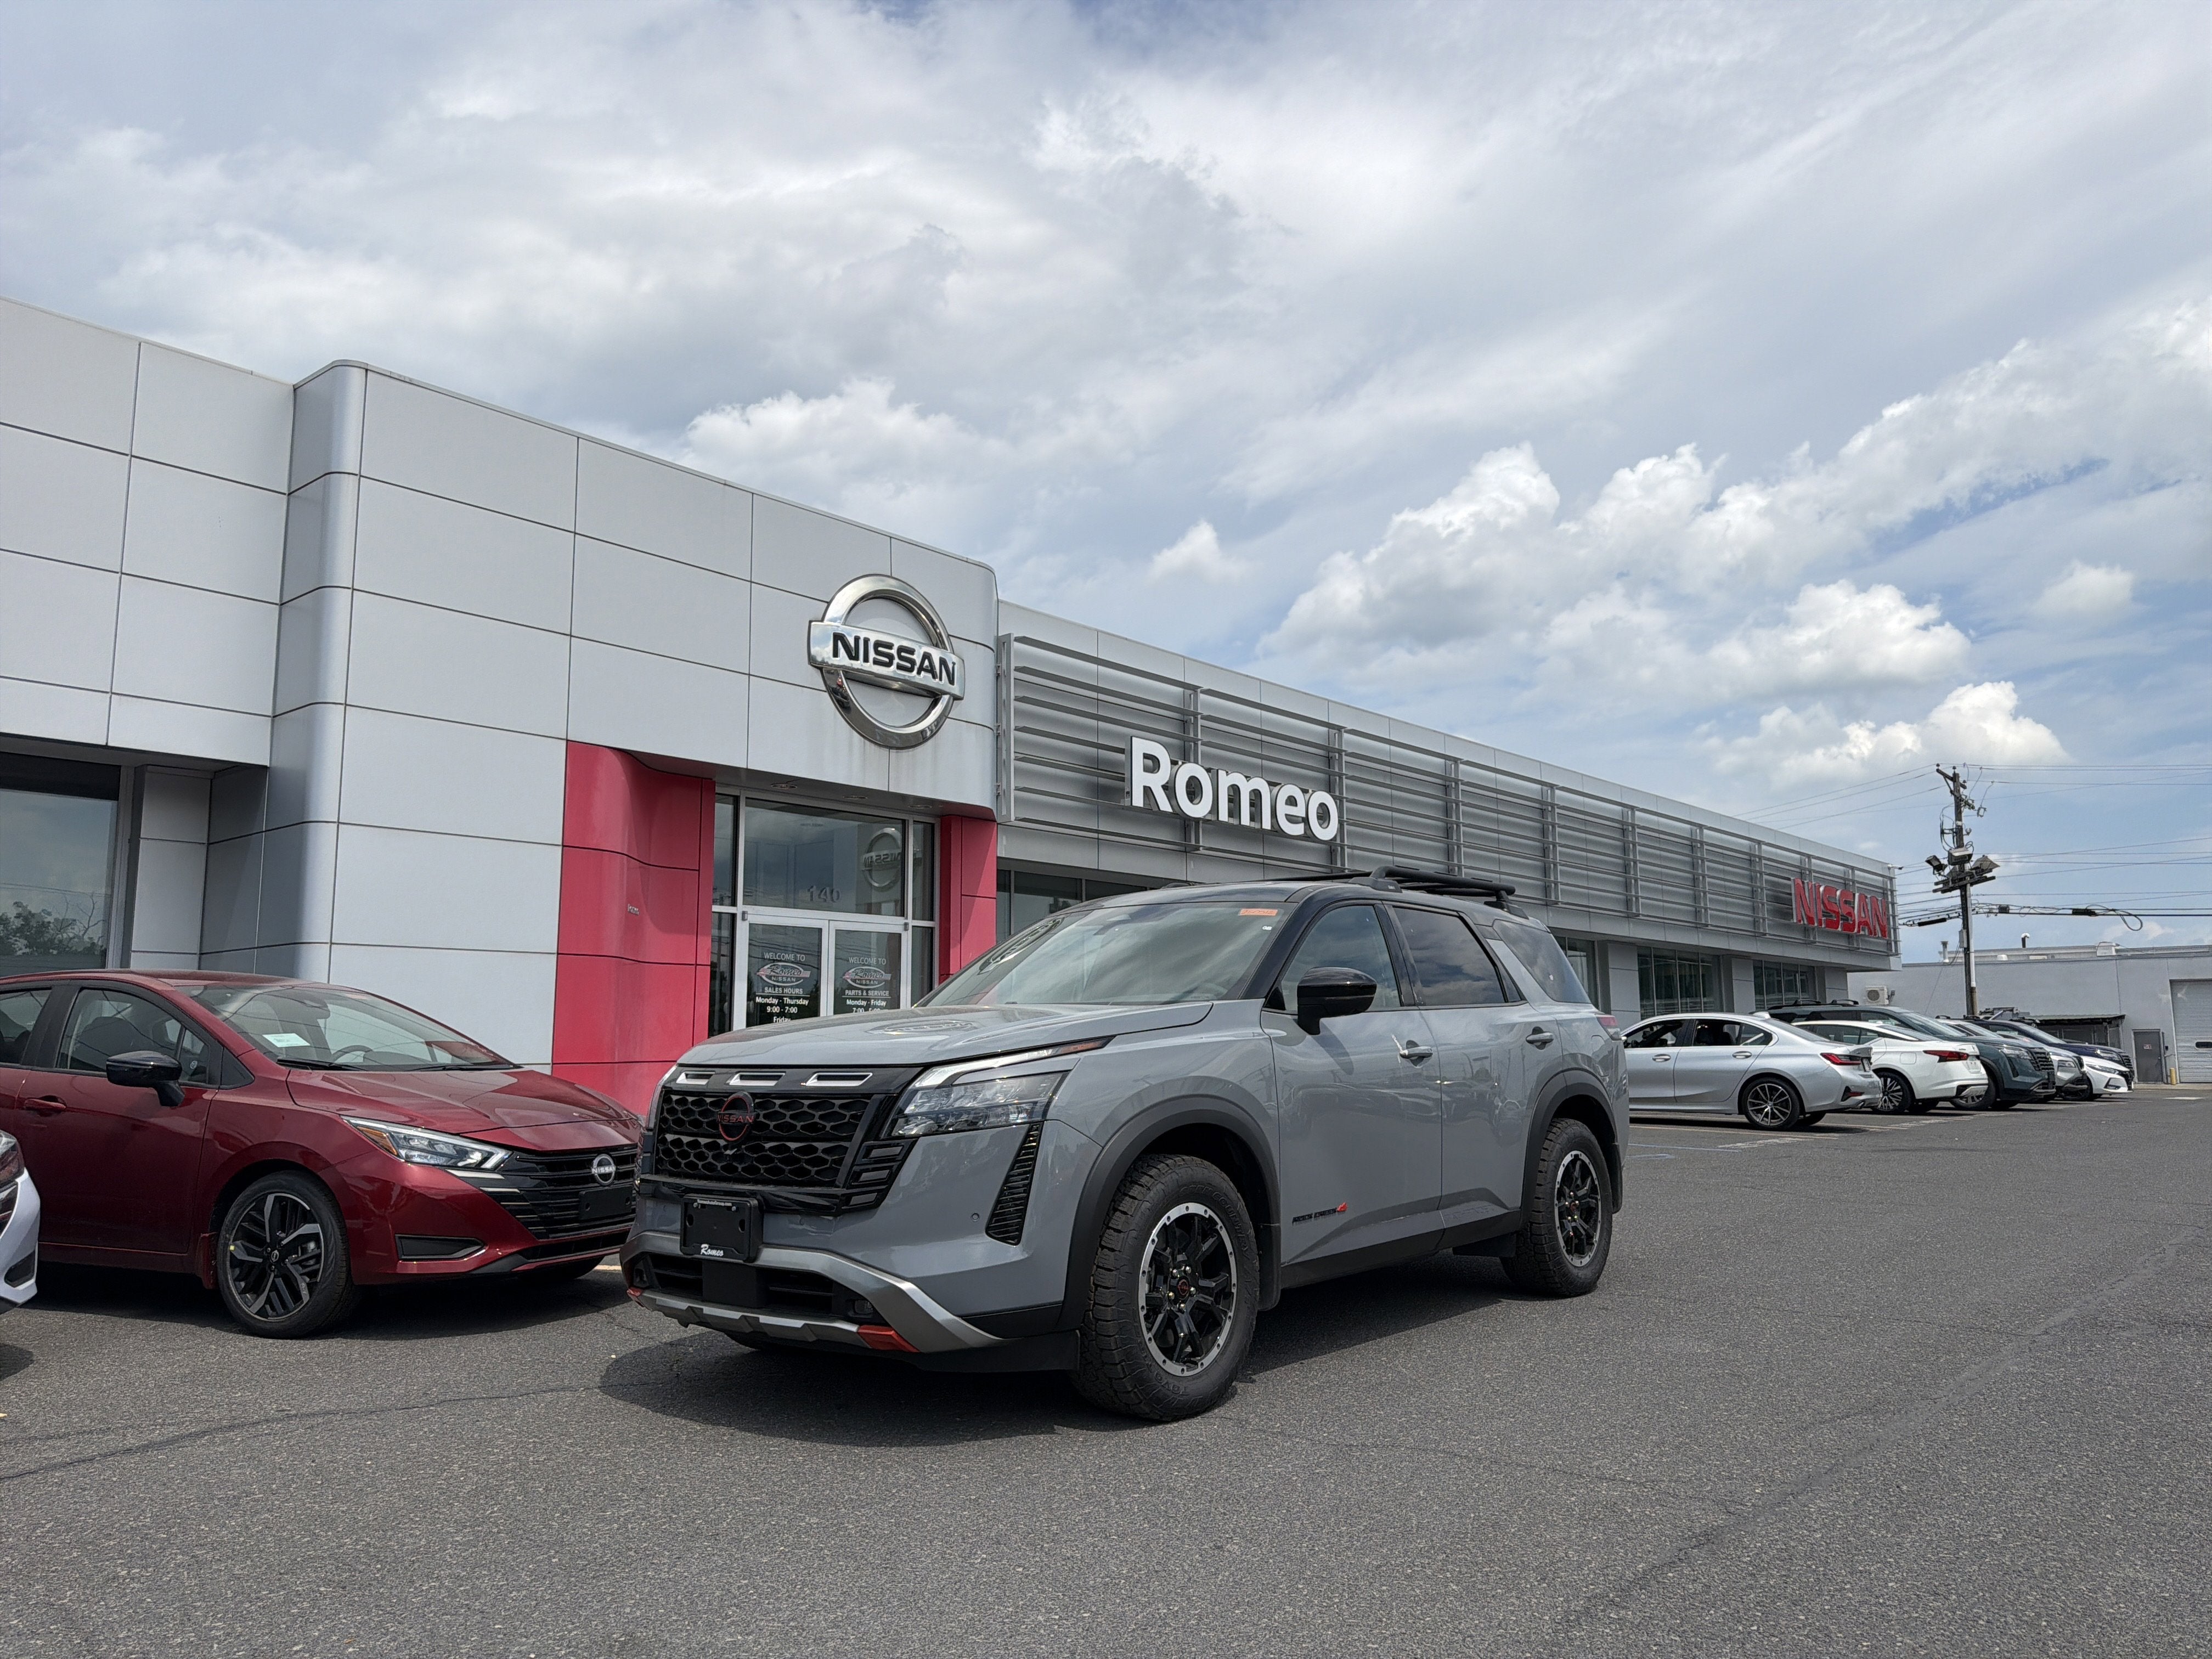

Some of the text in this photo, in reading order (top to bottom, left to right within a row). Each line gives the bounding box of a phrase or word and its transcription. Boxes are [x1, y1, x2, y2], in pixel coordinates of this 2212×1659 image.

[832, 632, 956, 686] NISSAN
[1129, 736, 1339, 841] Romeo
[808, 885, 840, 903] 140
[1792, 878, 1888, 939] NISSAN
[764, 952, 795, 961] WELCOME
[768, 964, 803, 977] Romeo
[854, 968, 884, 979] Romeo
[755, 996, 779, 1005] Monday
[783, 997, 809, 1006] Thursday
[716, 1114, 754, 1124] NISSAN
[592, 1166, 615, 1174] NISSAN
[700, 1244, 724, 1256] Romeo
